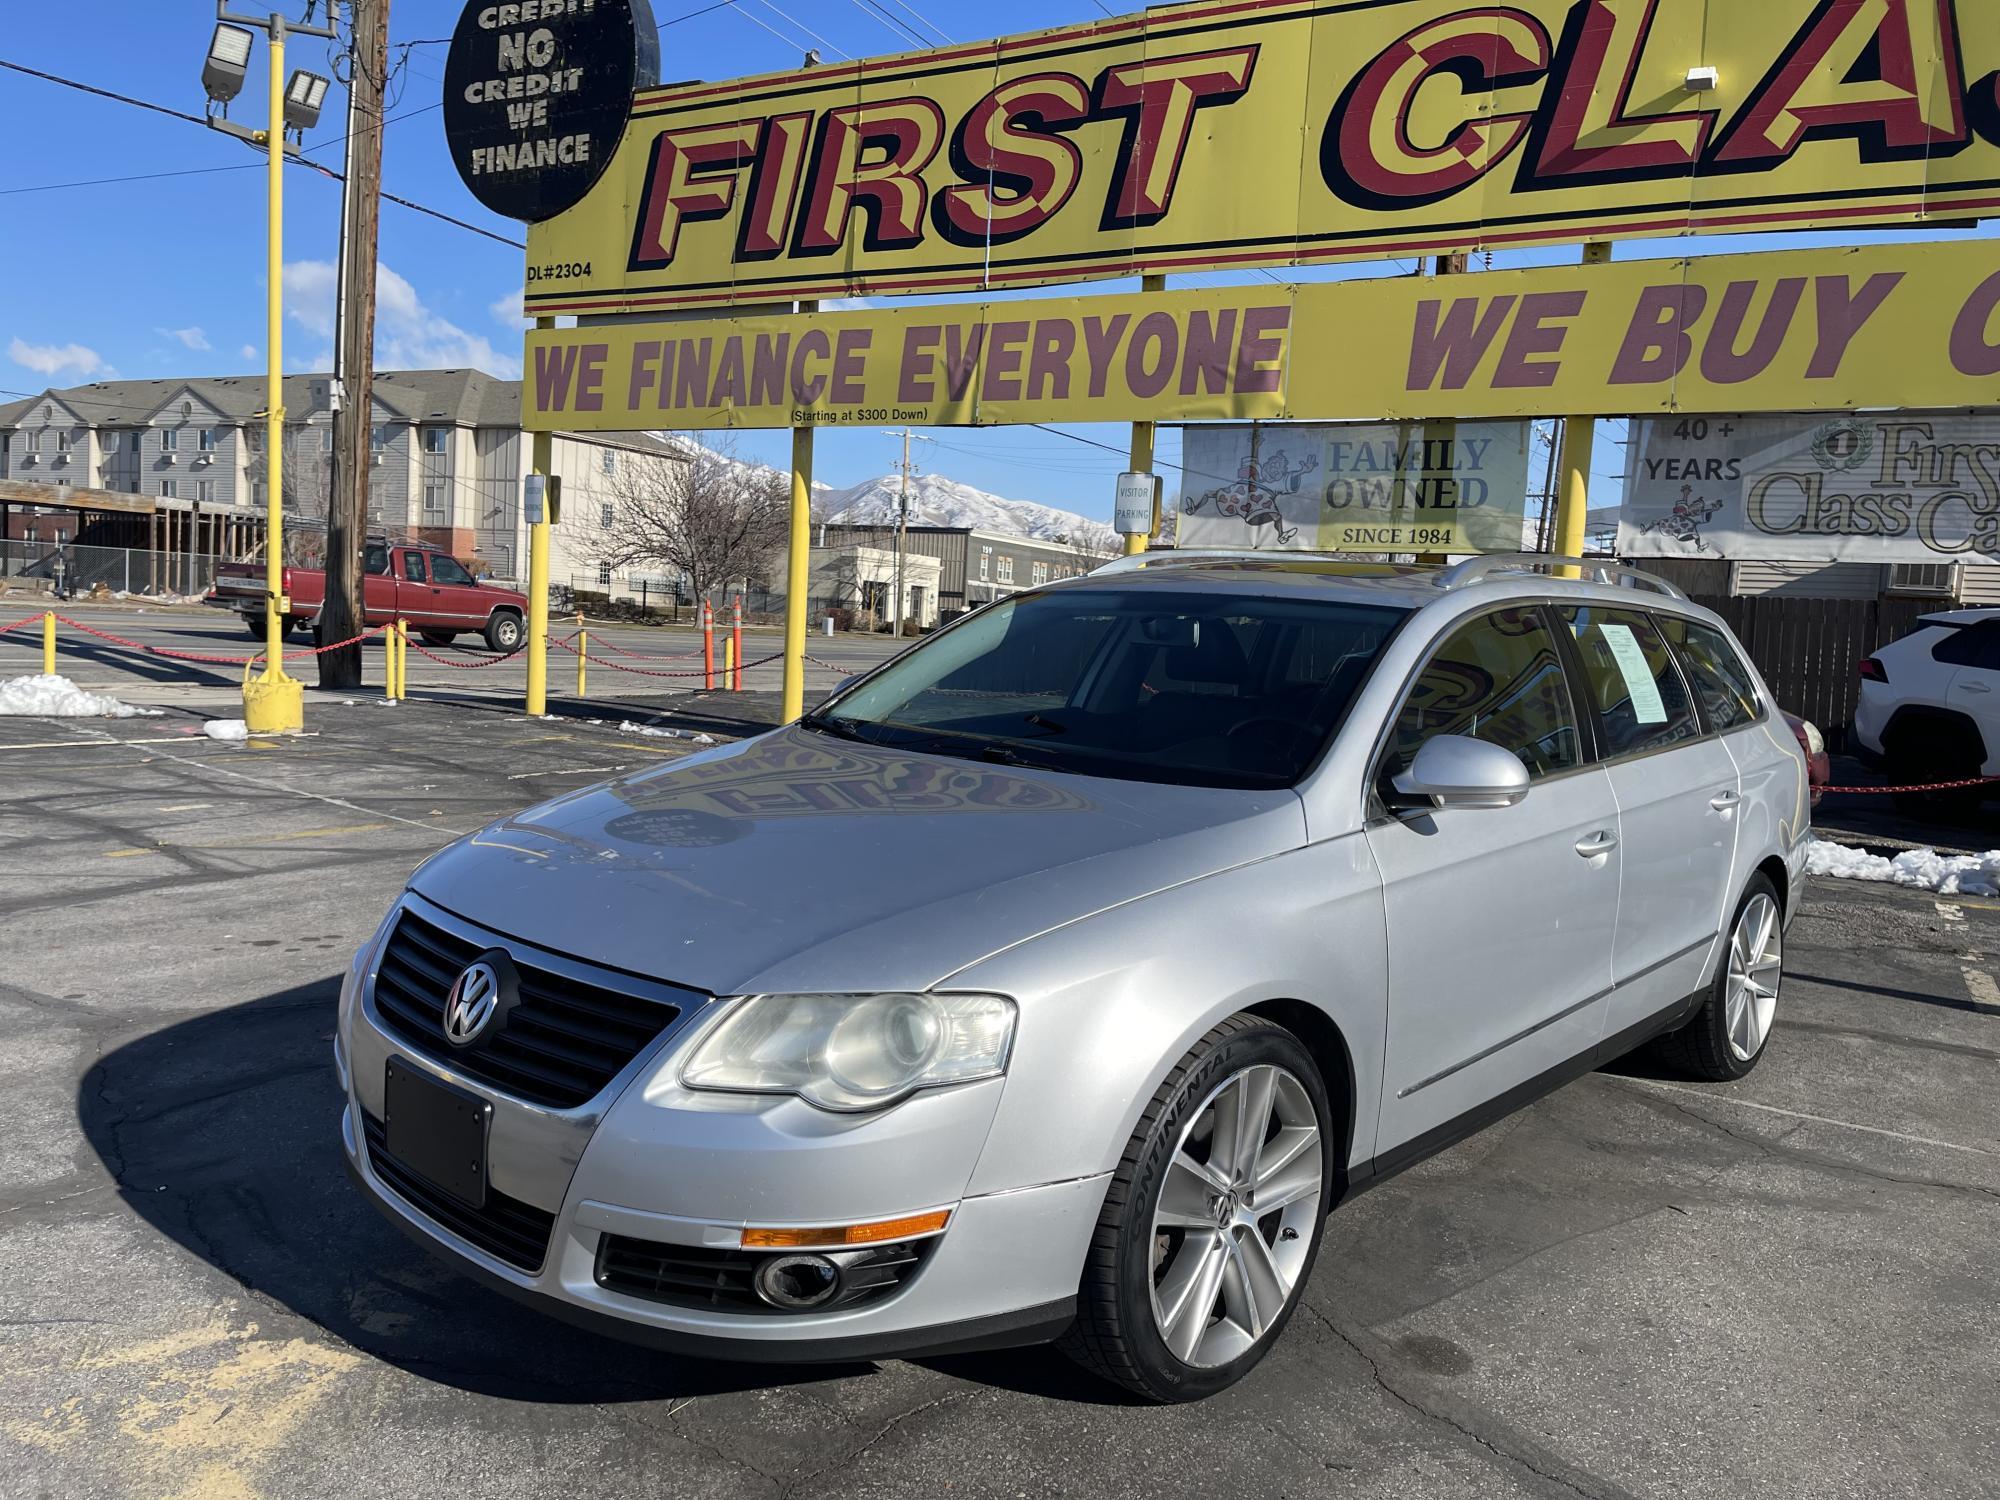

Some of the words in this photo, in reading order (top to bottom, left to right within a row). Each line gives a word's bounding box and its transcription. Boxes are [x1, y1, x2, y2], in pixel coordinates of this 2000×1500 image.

[498, 28, 555, 72] NO
[464, 68, 583, 103] CREDIT
[507, 101, 548, 130] WE
[626, 42, 1262, 272] FIRST
[1319, 0, 2000, 211] CLA
[472, 134, 590, 175] FINANCE
[527, 262, 592, 281] DL#2304
[1405, 290, 1588, 391] WE
[1607, 271, 1908, 385] BUY
[533, 344, 608, 411] WE
[627, 328, 873, 410] FINANCE
[898, 306, 1291, 402] EVERYONE
[790, 410, 837, 423] (Starting
[841, 410, 852, 421] at
[857, 409, 888, 421] $300
[892, 408, 928, 421] Down)
[1673, 418, 1709, 441] 40
[1328, 438, 1493, 472] FAMILY
[1645, 457, 1741, 481] YEARS
[1120, 487, 1149, 498] VISITOR
[1326, 477, 1489, 509] OWNED
[1747, 472, 1913, 536] Class
[1117, 509, 1149, 520] PARKING
[1342, 528, 1402, 544] SINCE
[1408, 528, 1452, 545] 1984
